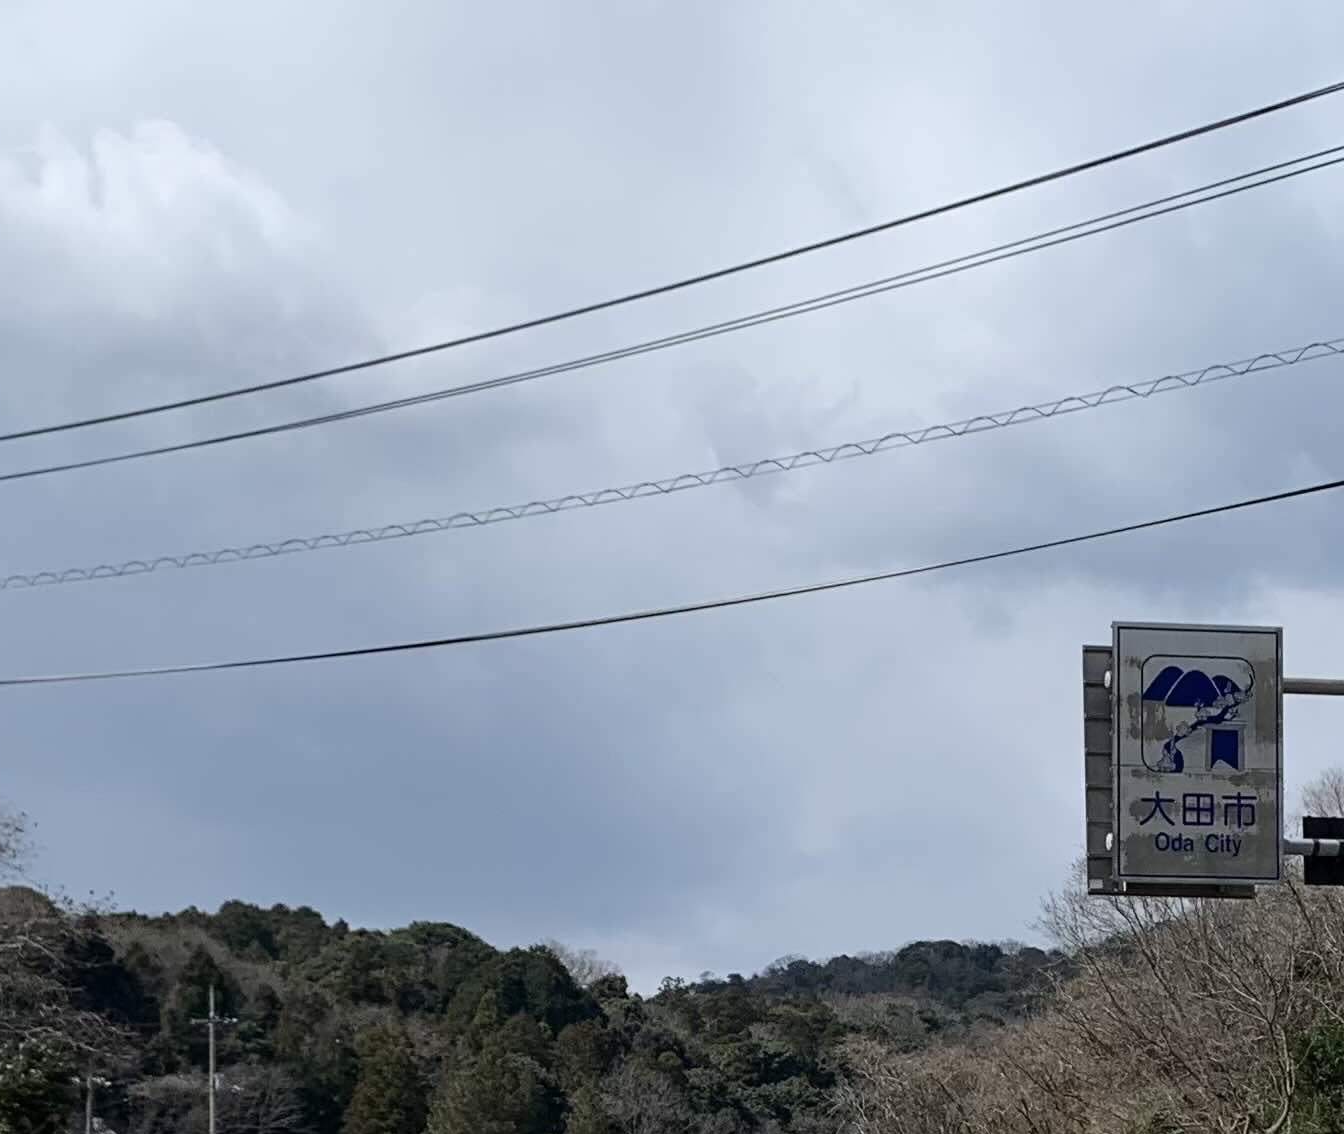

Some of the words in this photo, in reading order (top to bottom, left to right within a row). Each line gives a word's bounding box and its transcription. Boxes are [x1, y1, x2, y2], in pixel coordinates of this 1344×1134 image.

[1139, 790, 1258, 829] 大田市
[1155, 832, 1194, 852] Oda
[1205, 834, 1242, 857] City
